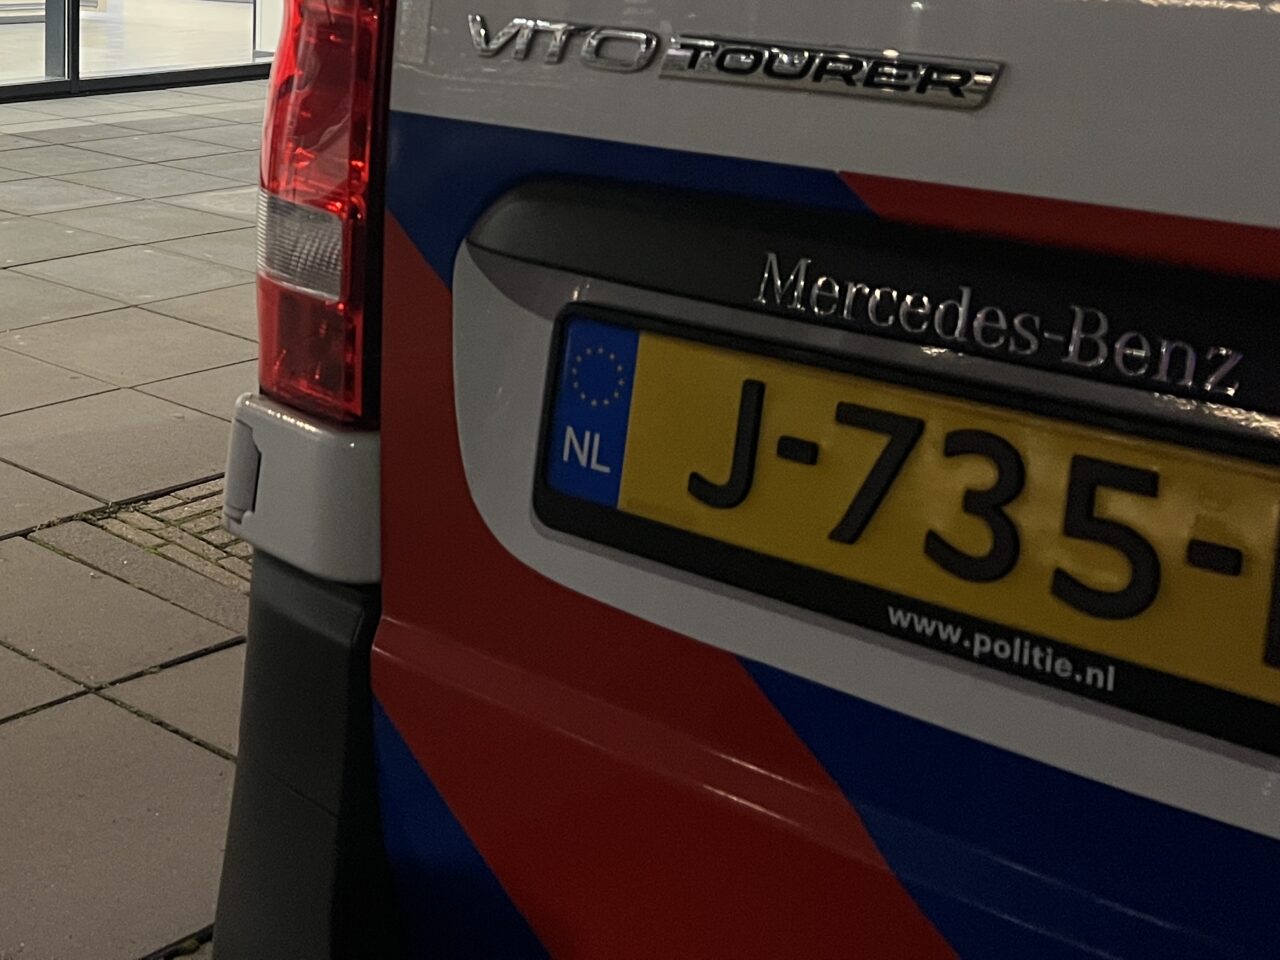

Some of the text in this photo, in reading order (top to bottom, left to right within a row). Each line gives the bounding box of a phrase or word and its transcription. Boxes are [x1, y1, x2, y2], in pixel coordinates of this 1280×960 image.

[468, 14, 974, 99] VITO TOURER
[754, 251, 1245, 398] Mercedes-Benz
[562, 425, 612, 474] NL
[687, 378, 1280, 670] J-735-
[887, 604, 1116, 692] www.politie.nl
